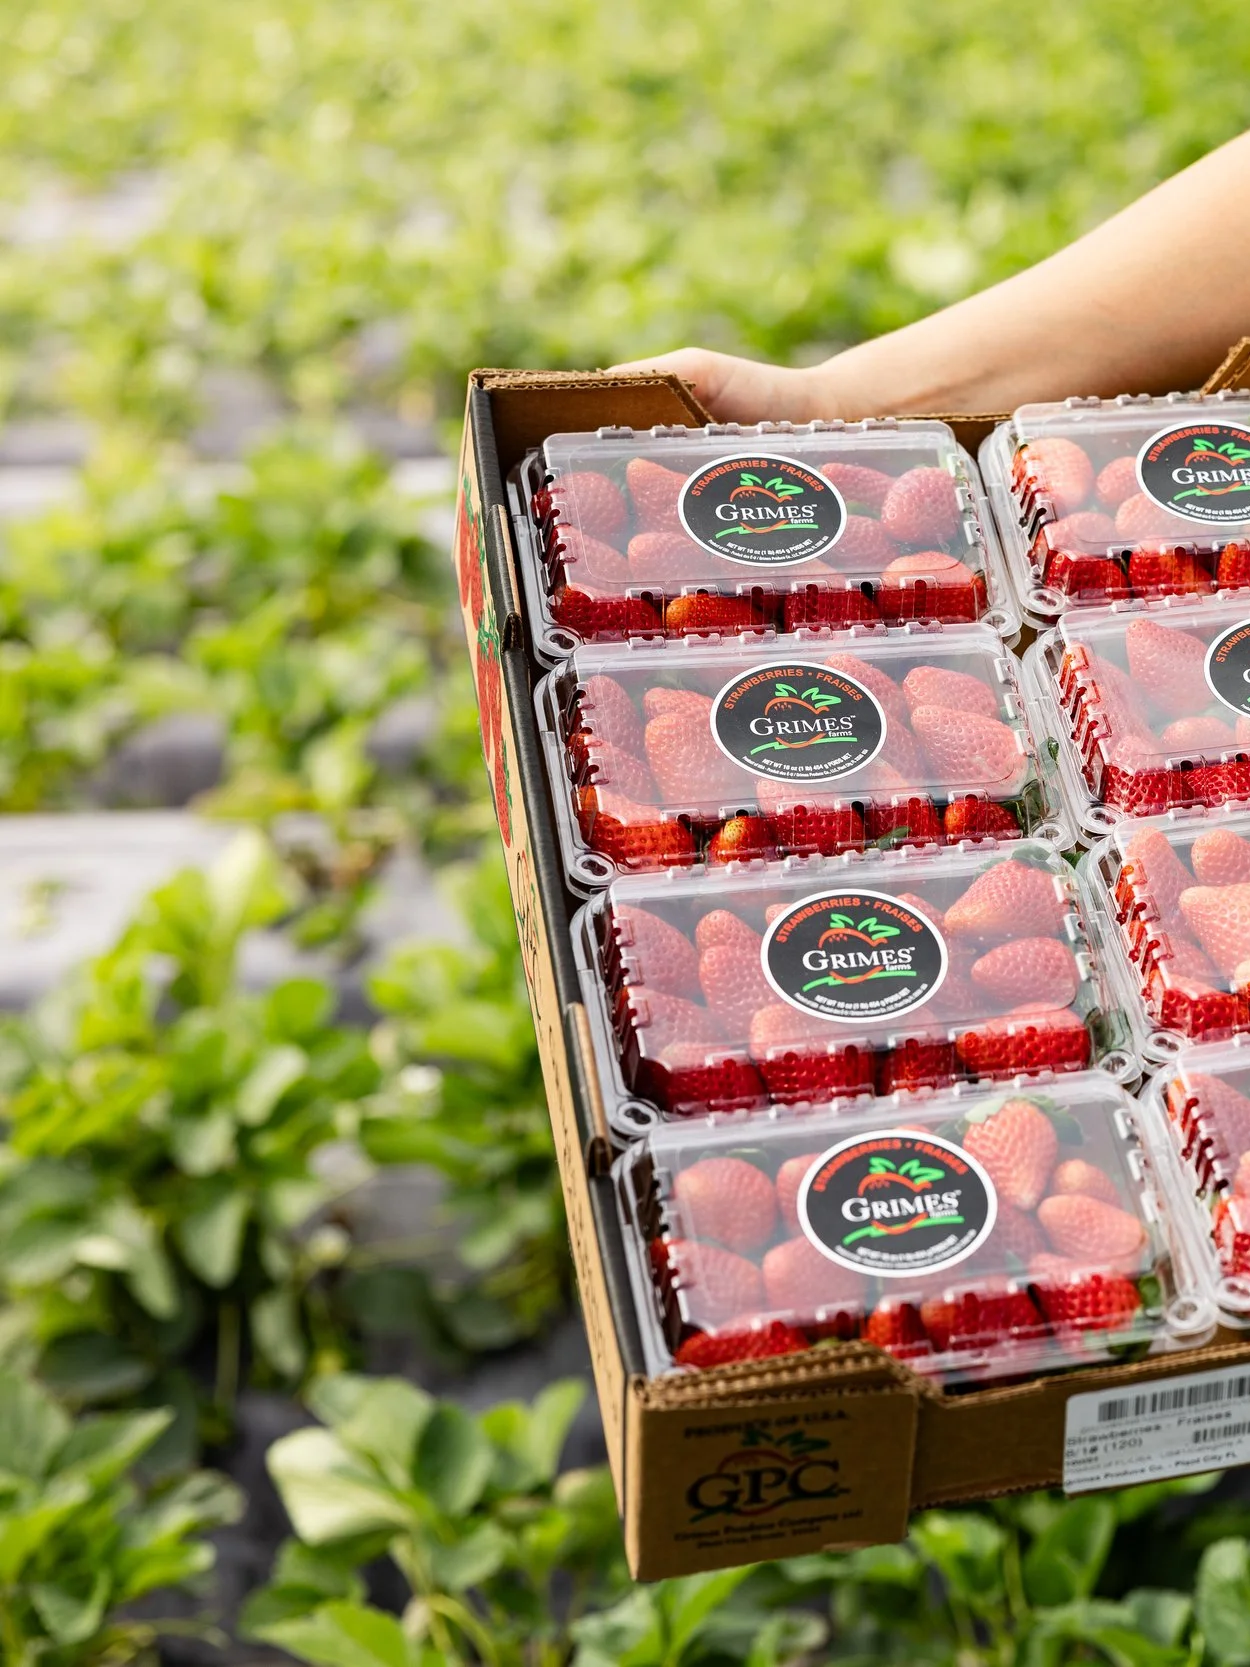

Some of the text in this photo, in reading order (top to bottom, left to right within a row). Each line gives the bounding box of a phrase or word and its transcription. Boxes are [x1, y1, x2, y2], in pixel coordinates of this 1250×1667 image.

[1148, 426, 1220, 462] STRAWBERRIES
[691, 460, 825, 497] STRAWBERRIES FRAISES
[715, 503, 815, 521] GRIMES
[790, 517, 814, 525] farms
[724, 668, 863, 710] STRAWBERRIES FRAISES
[749, 715, 853, 736] GRIMES
[828, 730, 853, 738] farms
[775, 897, 923, 943] STRAWBERRIES FRAISES
[802, 948, 912, 971] GRIMES
[841, 1191, 959, 1222] GRIMES
[1177, 1411, 1232, 1426] Fraises
[1103, 1437, 1143, 1454] (120)
[686, 1459, 840, 1510] GPC
